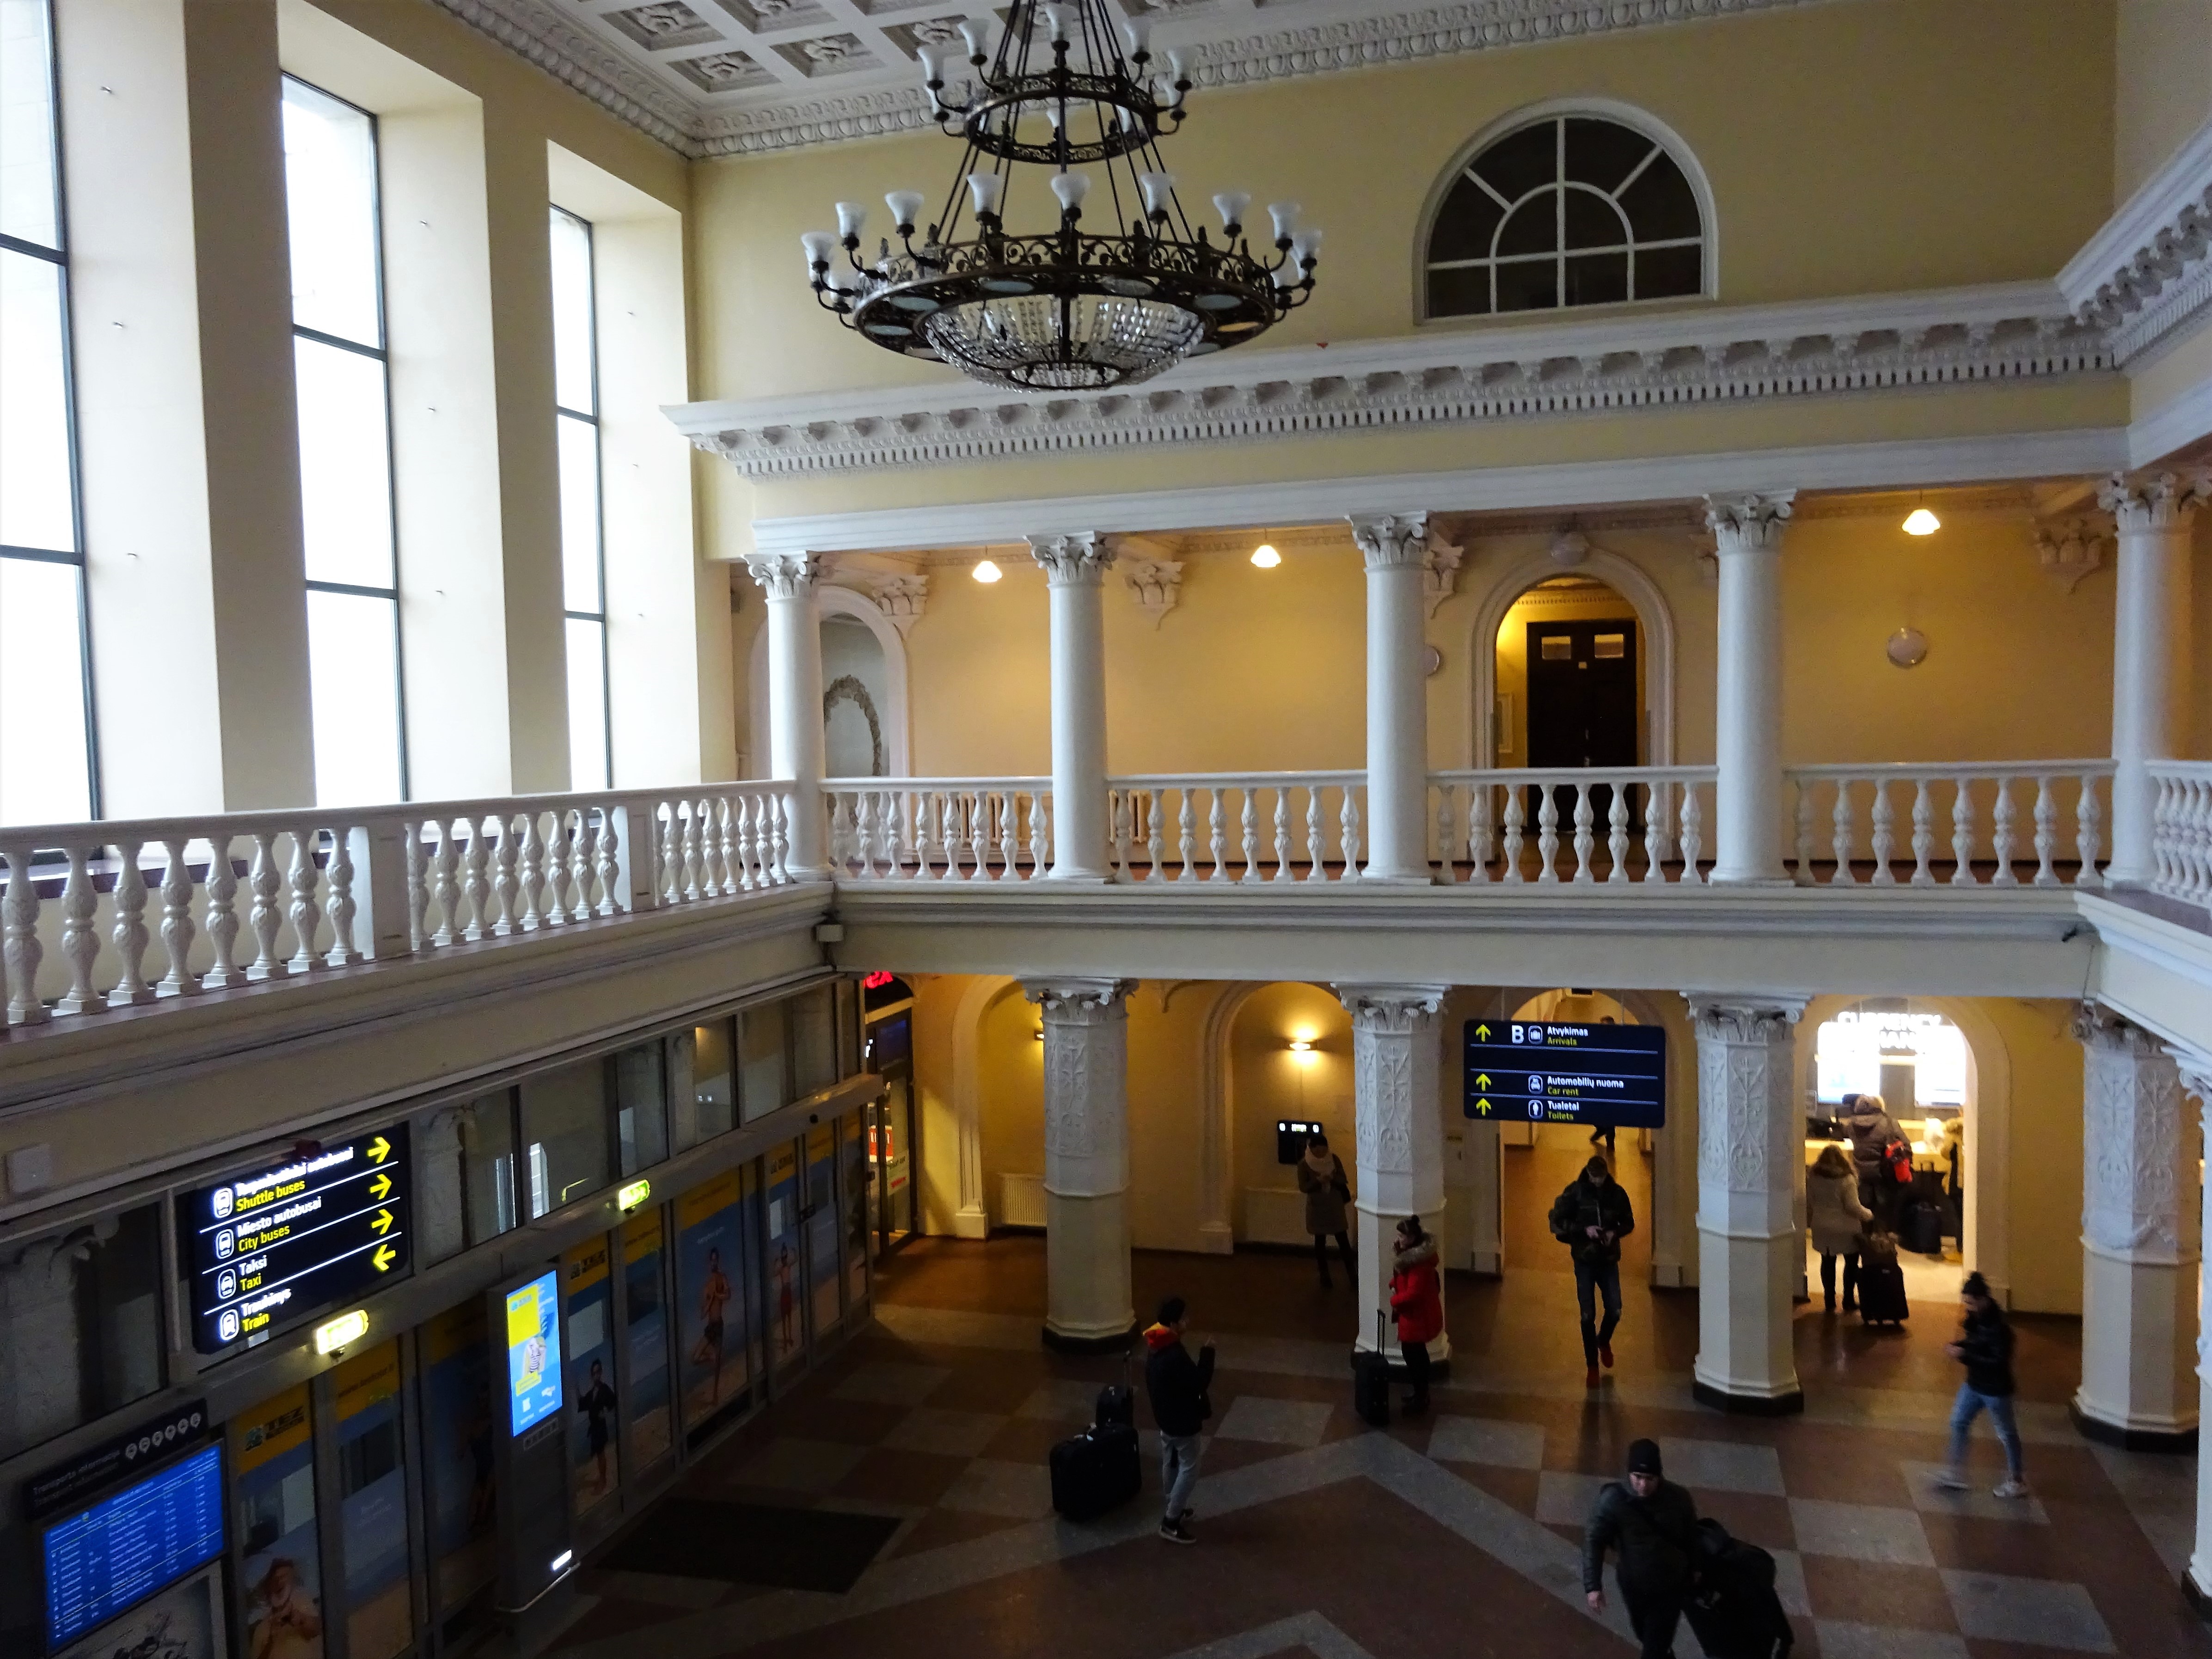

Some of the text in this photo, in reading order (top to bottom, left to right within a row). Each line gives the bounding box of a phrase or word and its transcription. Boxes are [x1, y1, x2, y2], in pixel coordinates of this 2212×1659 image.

[1512, 1025, 1524, 1044] B
[1547, 1026, 1588, 1037] Atvykimas
[1547, 1037, 1577, 1046] Arrivals
[1548, 1087, 1579, 1096] Car rent
[1596, 1079, 1624, 1089] nuoma
[1547, 1100, 1579, 1111] Tualetai
[1548, 1111, 1574, 1120] Toilets
[236, 1180, 306, 1212] Shuttle buses
[237, 1196, 322, 1237] Miesto autobusai
[239, 1225, 290, 1252] City buses
[239, 1255, 267, 1276] Taksi
[240, 1273, 262, 1291] Taxi
[242, 1313, 270, 1332] Train
